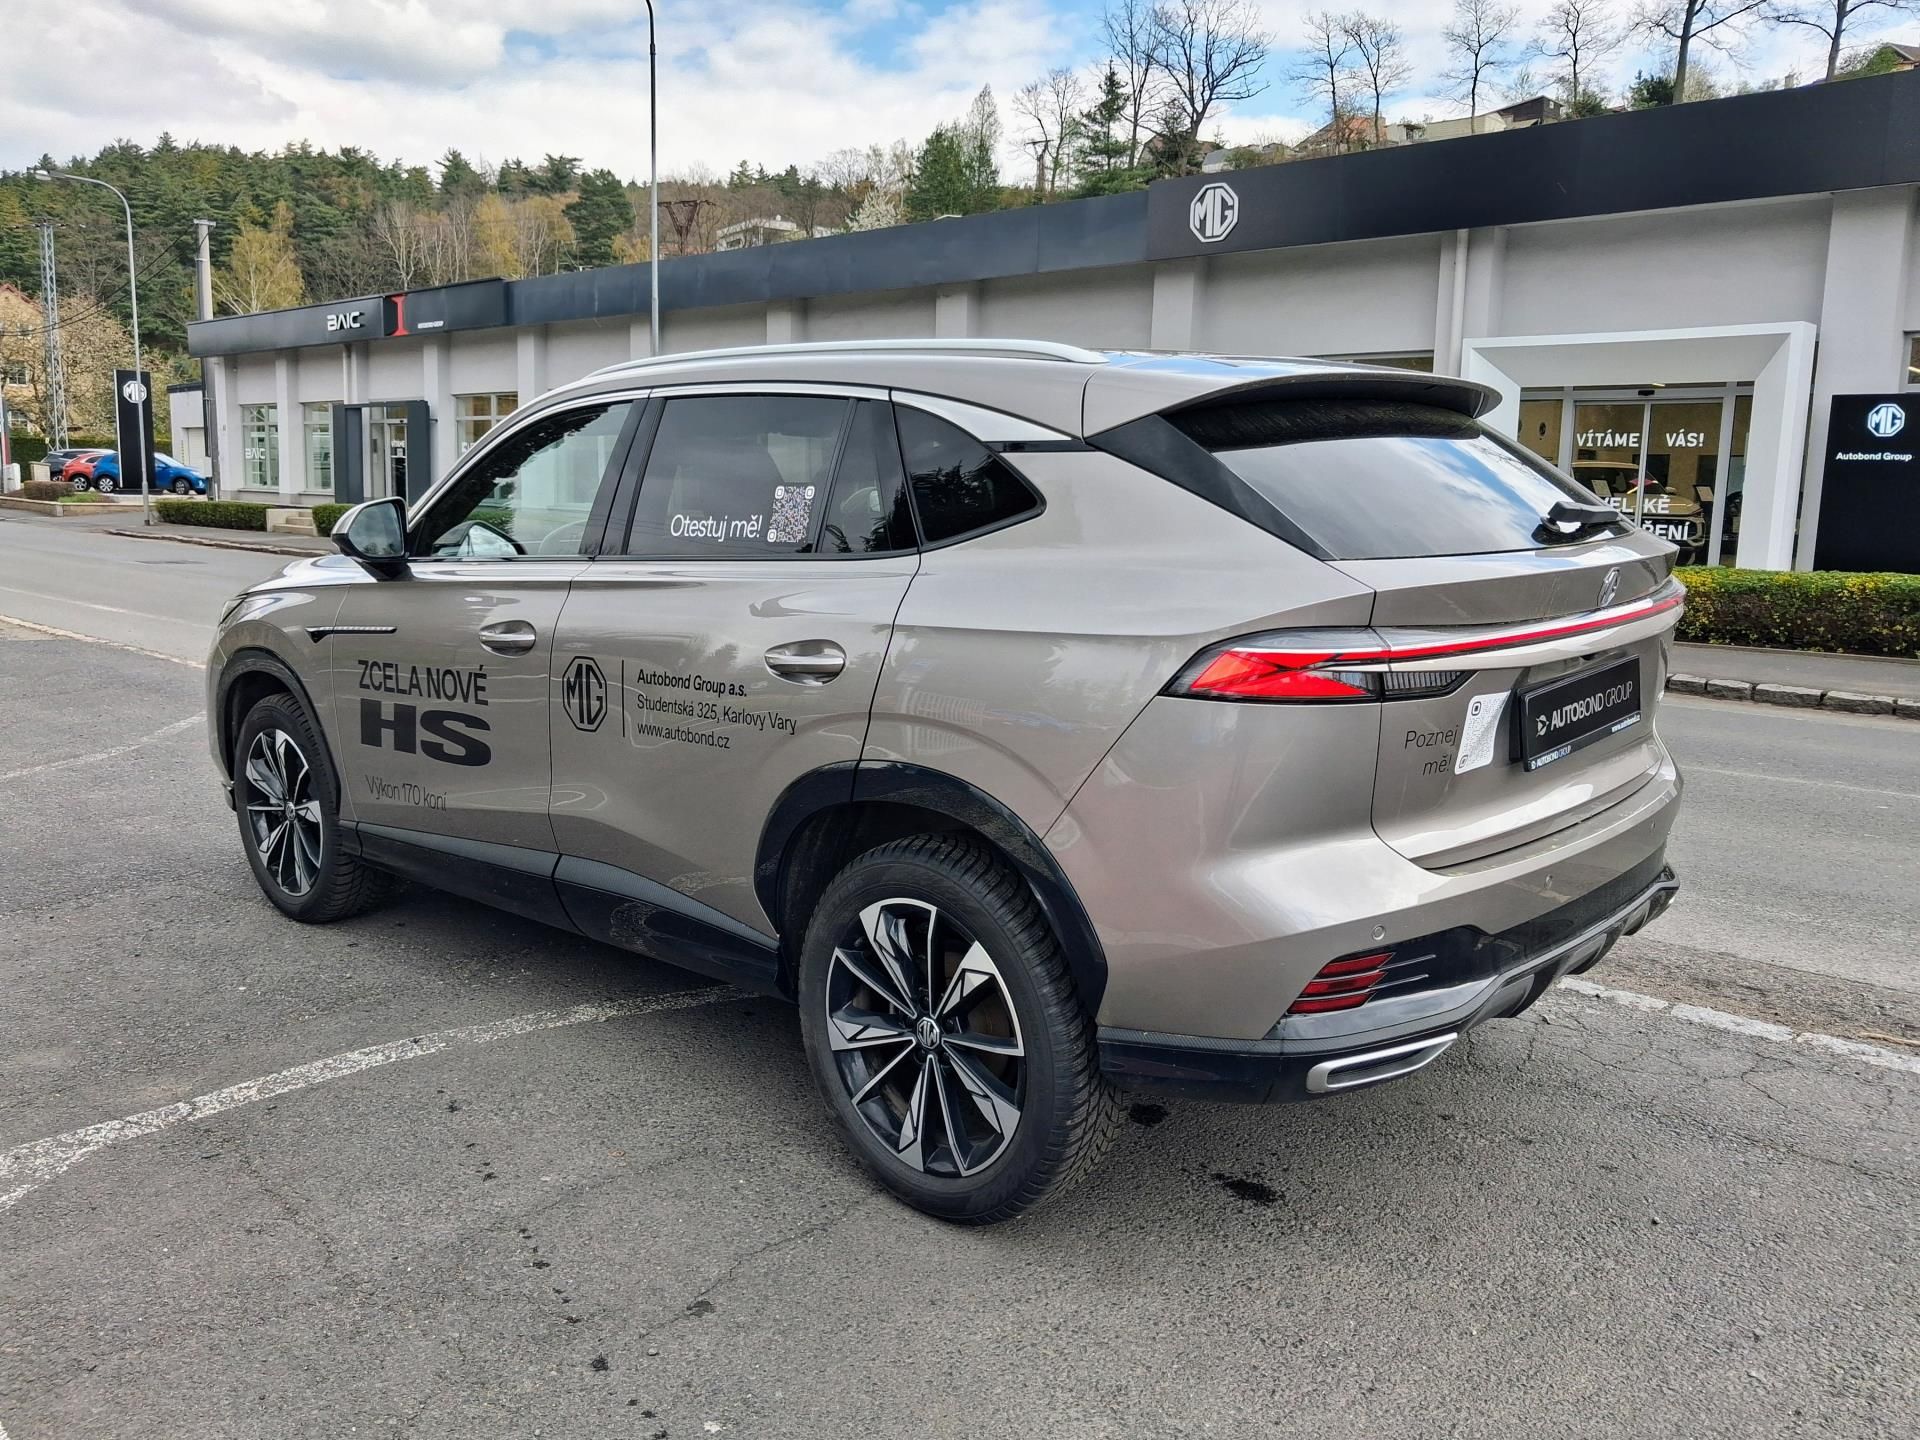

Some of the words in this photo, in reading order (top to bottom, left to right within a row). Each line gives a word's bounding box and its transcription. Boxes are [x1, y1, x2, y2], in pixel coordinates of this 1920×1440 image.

[1192, 185, 1236, 240] MG
[326, 311, 361, 331] BAIC
[1870, 405, 1903, 435] MG
[1576, 429, 1640, 447] VÍTÁME
[1665, 429, 1705, 447] VÁS!
[1835, 452, 1881, 461] Autobond
[1883, 453, 1913, 463] Group
[670, 514, 728, 542] Otestuj
[729, 514, 763, 539] mě!
[1642, 520, 1691, 541] ŘENÍ
[357, 659, 423, 697] ZCELA
[426, 665, 489, 706] NOVÉ
[565, 660, 605, 728] MG
[637, 668, 691, 690] Autobond
[693, 675, 726, 698] Group
[728, 682, 748, 697] a.s.
[637, 693, 694, 716] Studentská
[696, 702, 720, 722] 325,
[723, 706, 766, 731] Karlovy
[768, 712, 797, 735] Vary
[1550, 692, 1604, 731] AUTOBOND
[1605, 681, 1633, 708] GROUP
[360, 698, 492, 767] HS
[637, 722, 730, 749] www.autobond.cz
[1404, 725, 1459, 750] Poznej
[1422, 753, 1452, 776] mě!
[364, 774, 400, 800] Výkon
[402, 783, 421, 805] 170
[423, 786, 447, 812] koní
